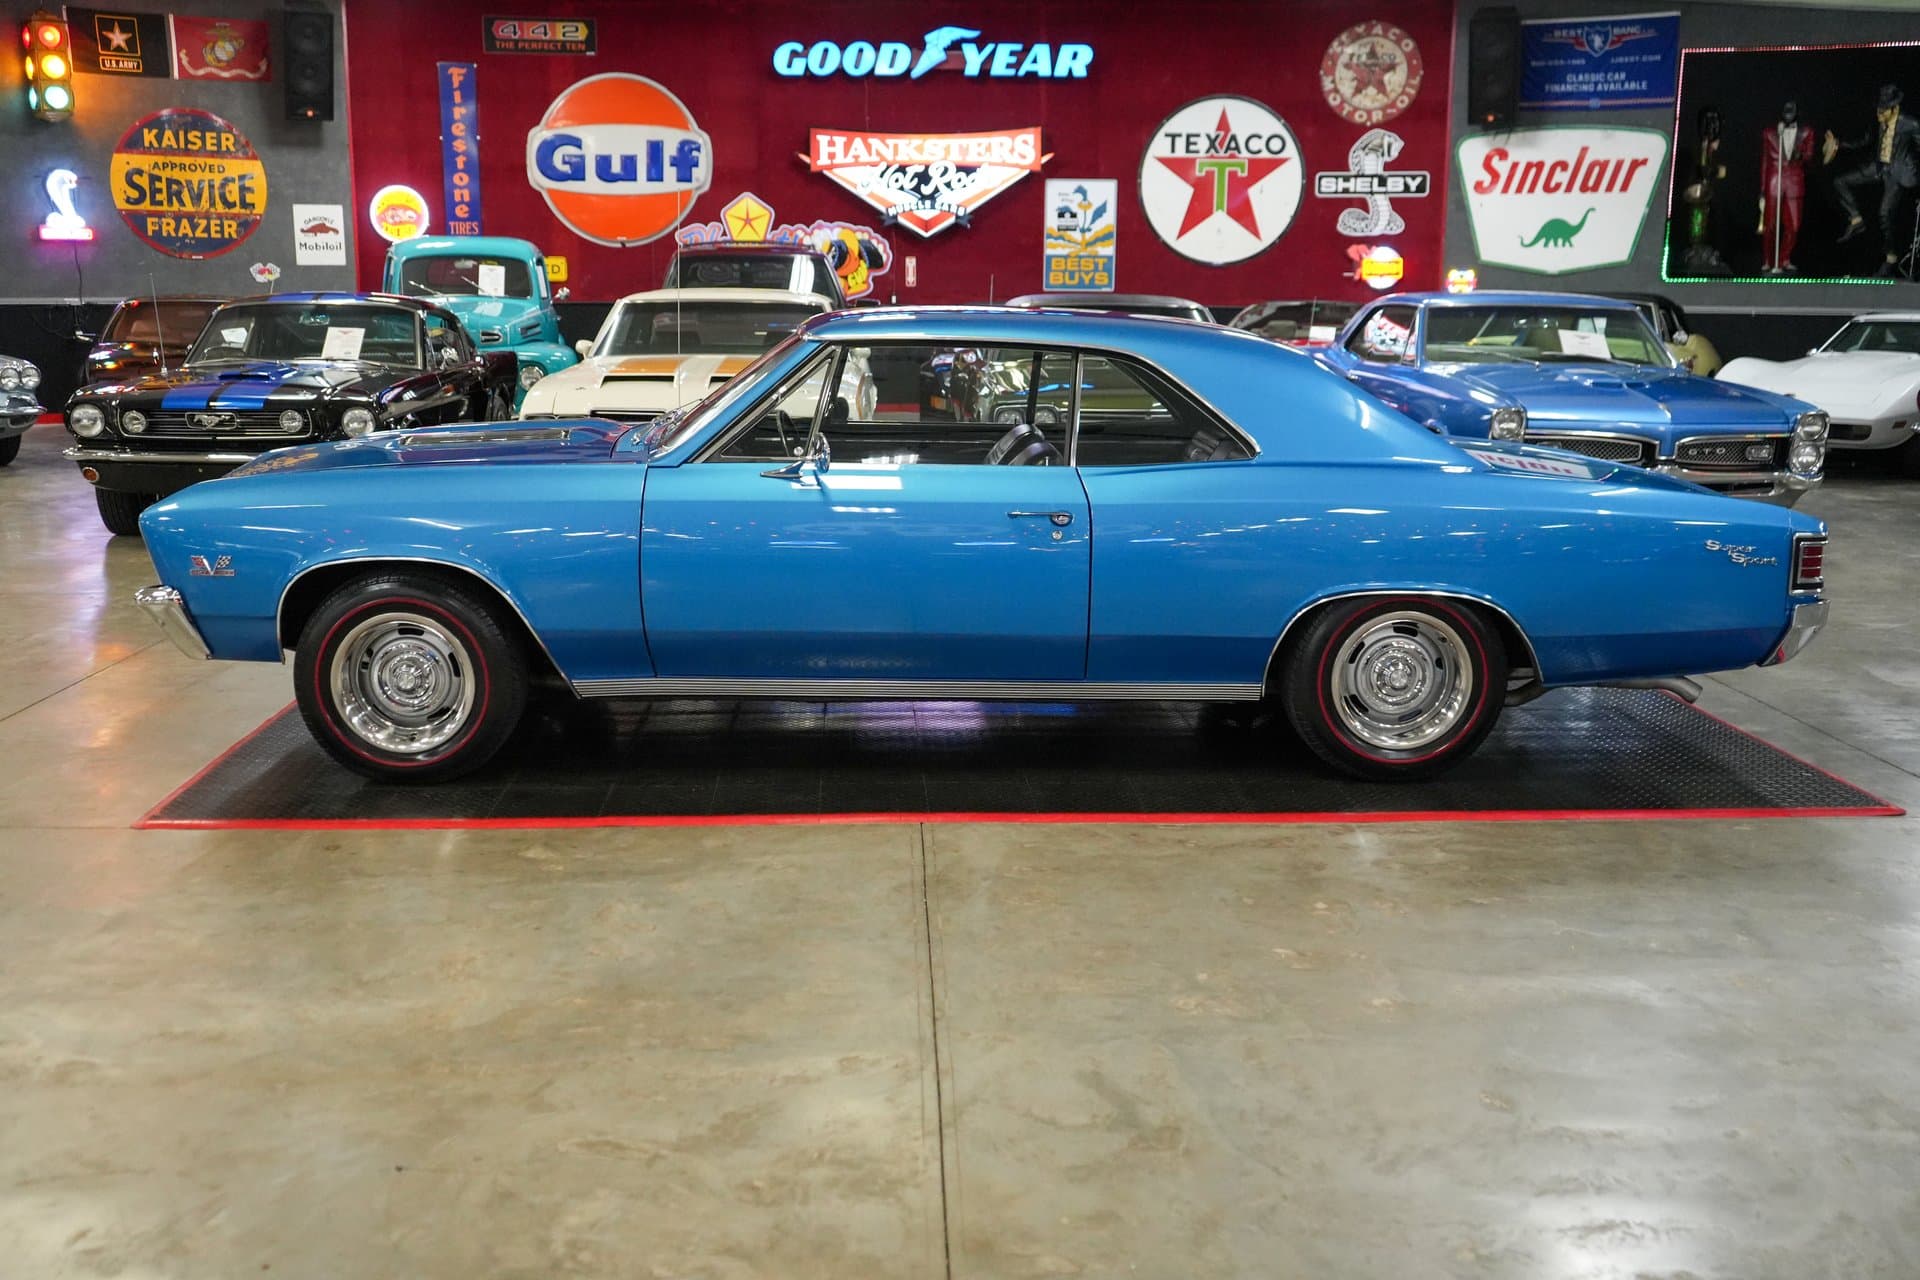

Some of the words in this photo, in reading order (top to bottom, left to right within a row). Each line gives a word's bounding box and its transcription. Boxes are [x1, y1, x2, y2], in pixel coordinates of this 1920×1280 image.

[495, 41, 515, 49] THE
[518, 41, 562, 50] PERFECT
[566, 41, 586, 51] TEN
[104, 59, 118, 68] U.S.
[119, 60, 138, 69] ARMY
[1566, 72, 1605, 82] CLASSIC
[1607, 71, 1627, 81] CAR
[1545, 82, 1595, 93] FINANCING
[1596, 80, 1648, 91] AVAILABLE
[142, 127, 236, 152] KAISER
[447, 66, 471, 219] Firestone
[1164, 132, 1287, 155] TEXACO
[536, 133, 702, 183] Gulf
[815, 133, 1036, 167] HANKSTERS
[151, 161, 226, 174] APPROVED
[1474, 146, 1649, 195] Sinclair
[857, 161, 925, 195] Hot
[1196, 158, 1249, 213] T
[1319, 176, 1424, 193] SHELBY
[124, 167, 256, 210] SERVICE
[887, 199, 931, 217] MUSCLE
[146, 217, 239, 239] FRAZER
[448, 220, 479, 235] TIRES
[299, 241, 342, 251] Mobiloil
[1051, 257, 1108, 271] BEST
[1049, 271, 1109, 285] BUYS
[1704, 539, 1757, 555] Super
[1731, 552, 1778, 567] Sport
